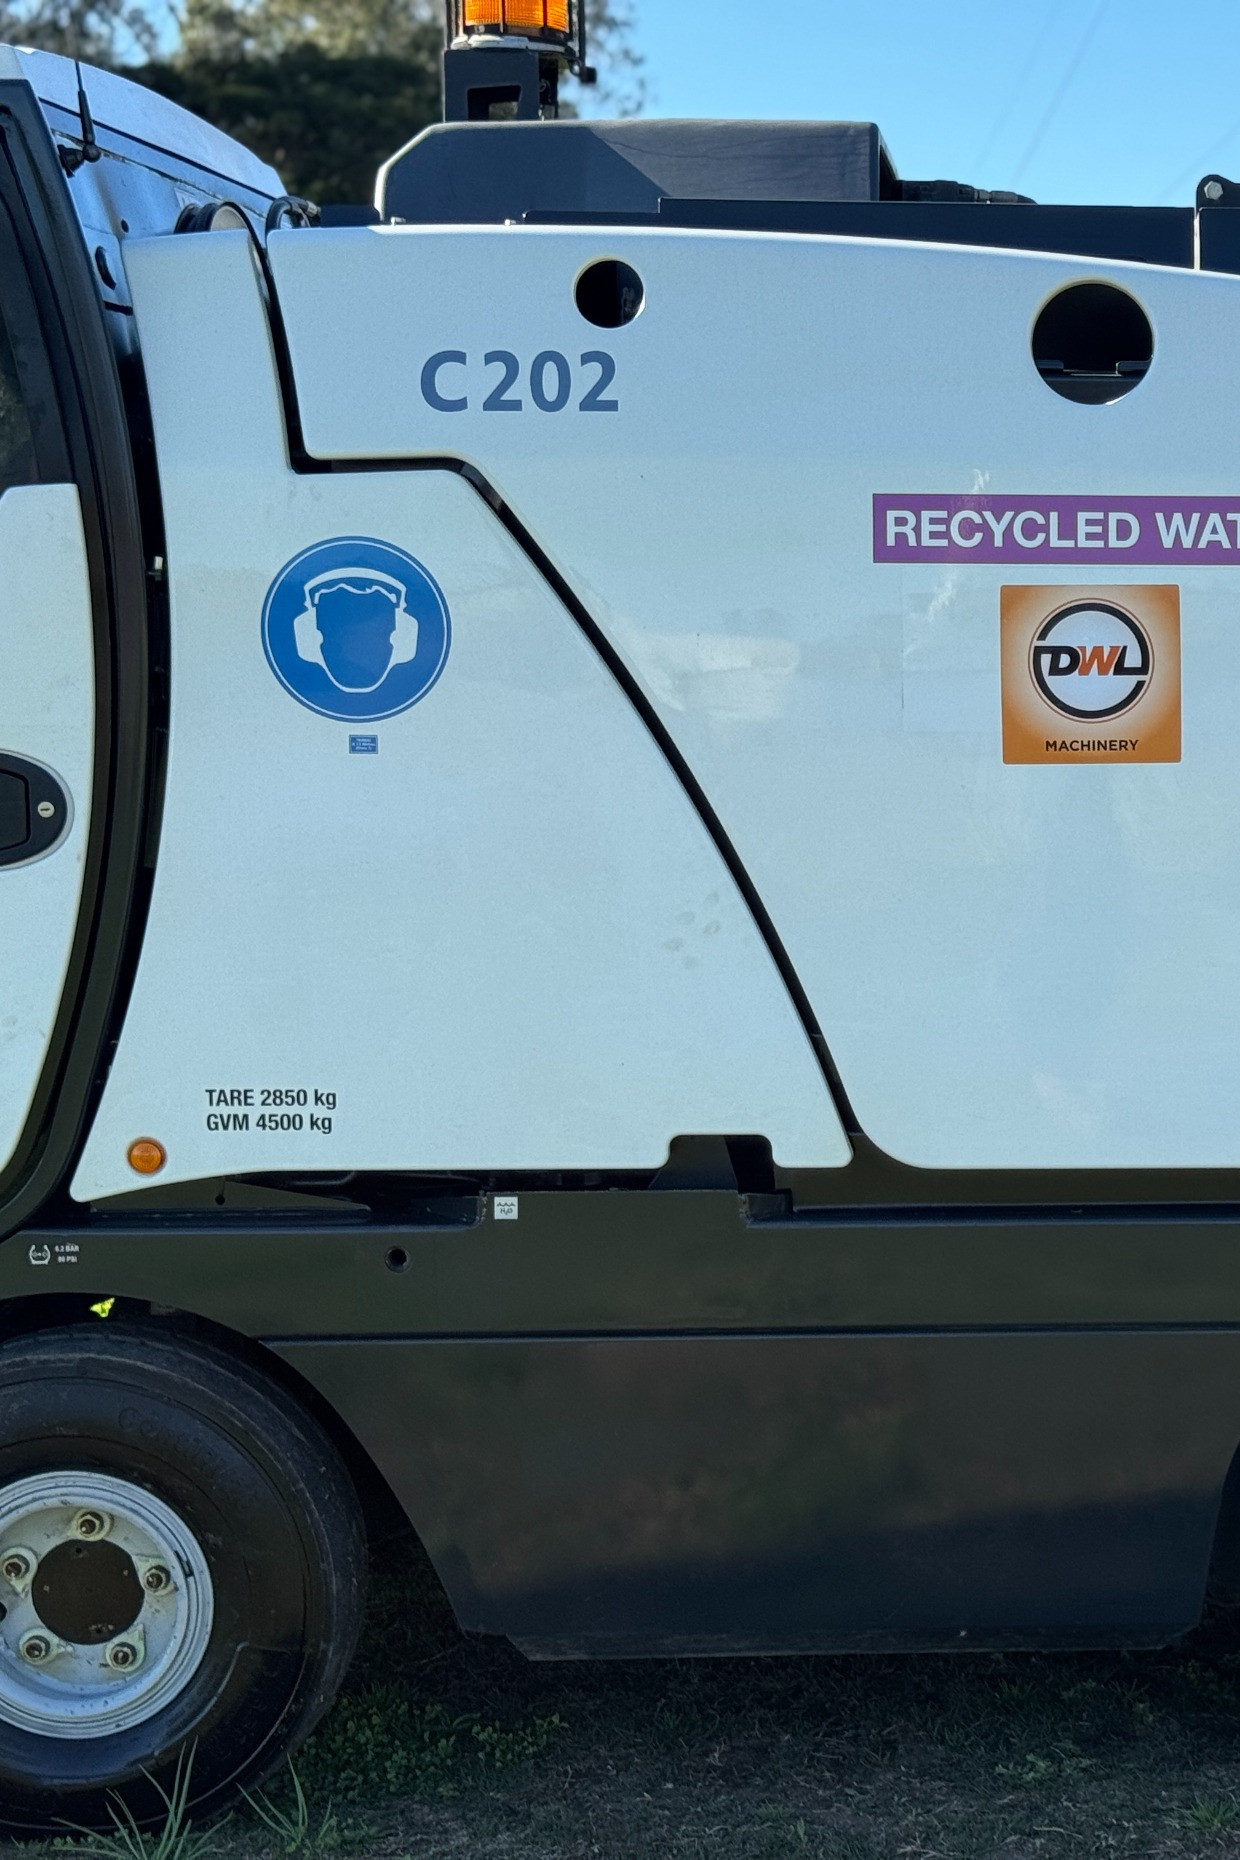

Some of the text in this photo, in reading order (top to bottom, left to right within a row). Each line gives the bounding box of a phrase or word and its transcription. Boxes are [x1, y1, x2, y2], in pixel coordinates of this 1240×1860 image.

[420, 349, 619, 413] C202
[885, 509, 1141, 549] RECYCLED
[1033, 645, 1150, 676] DWL
[1045, 739, 1139, 752] MACHINERY
[205, 1088, 337, 1110] TARE 2850 kg
[206, 1113, 333, 1135] GVM 4500 kg
[65, 1244, 80, 1253] BAR
